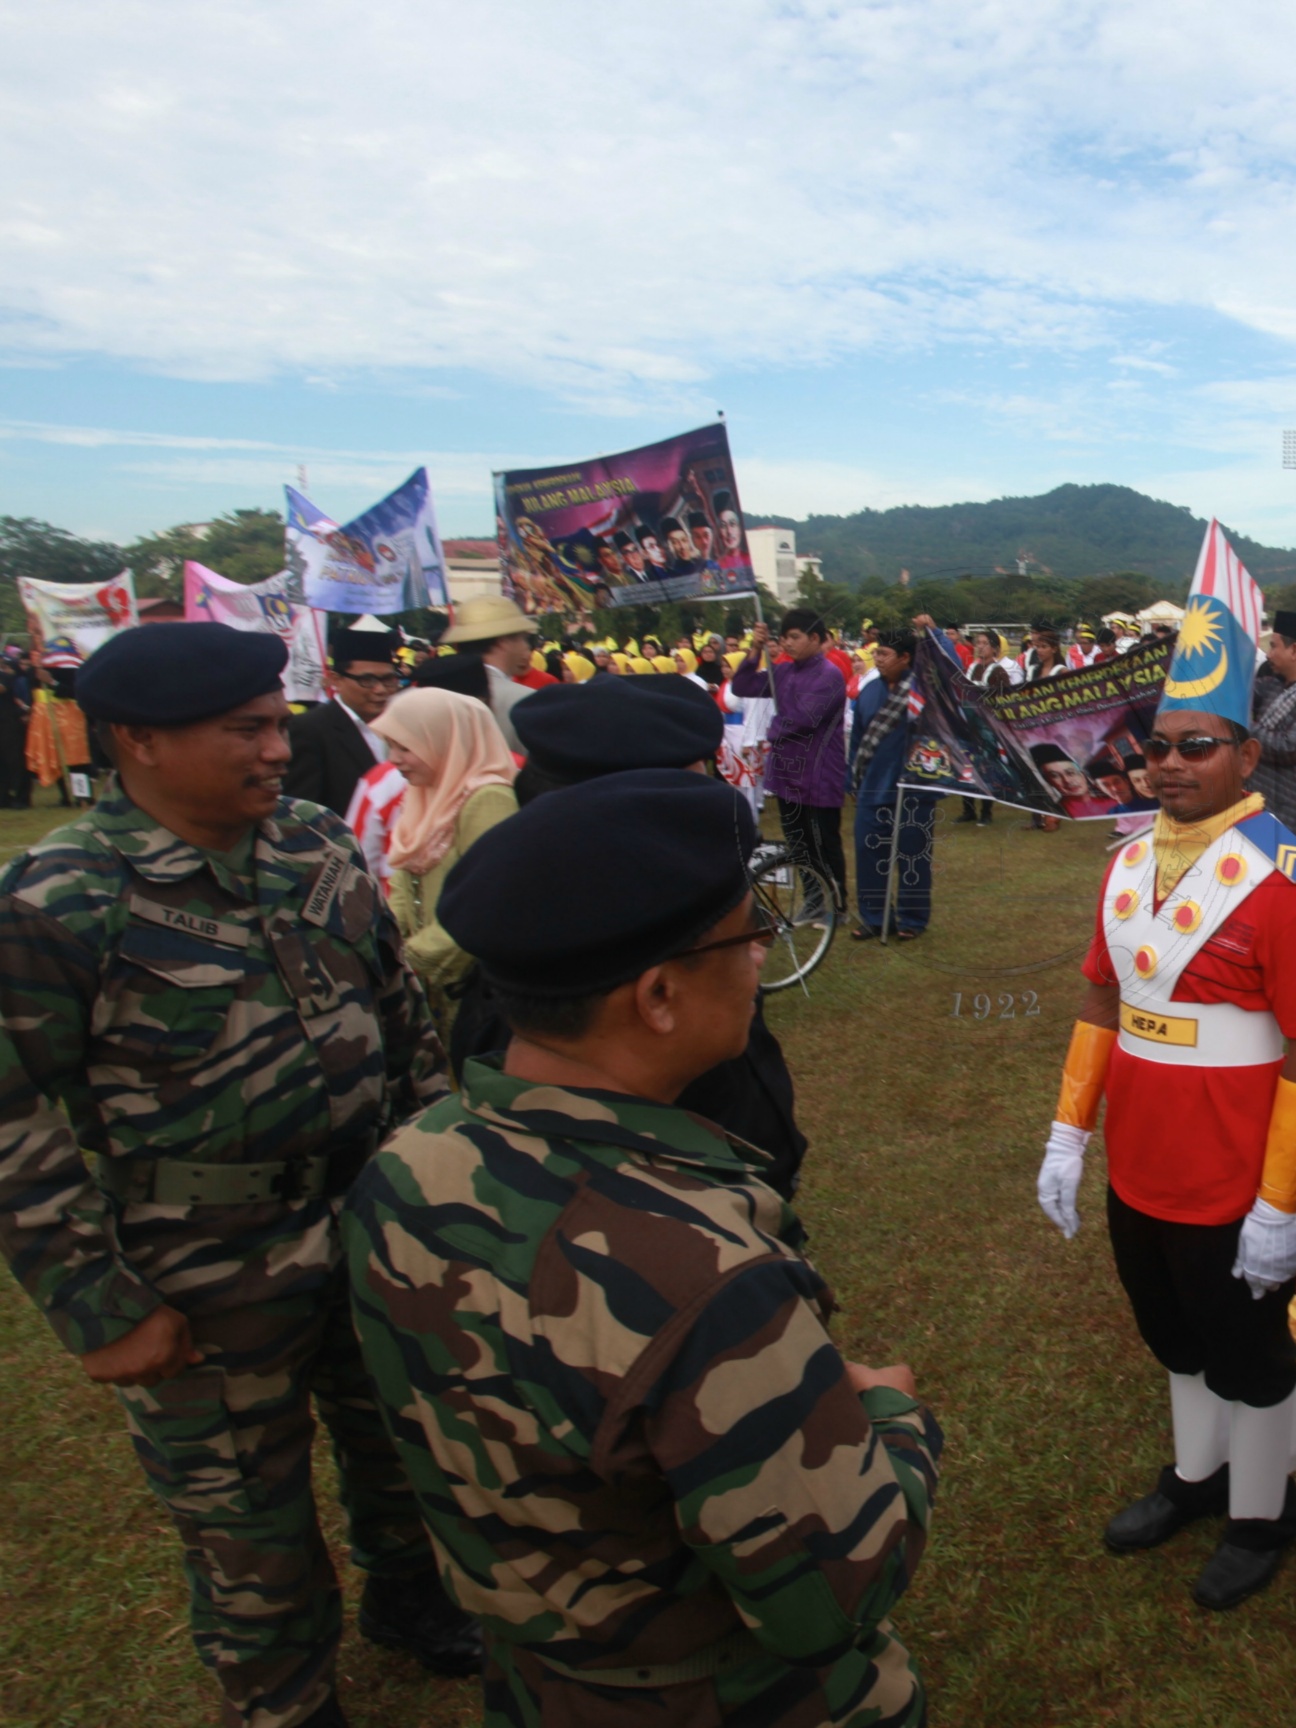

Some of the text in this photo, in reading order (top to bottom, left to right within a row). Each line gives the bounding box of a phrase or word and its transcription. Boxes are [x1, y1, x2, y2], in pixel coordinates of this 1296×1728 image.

[566, 477, 637, 507] MALAYSIA
[307, 855, 344, 917] WATANIAH
[162, 908, 219, 936] TALIB
[1131, 1015, 1168, 1037] HEPA
